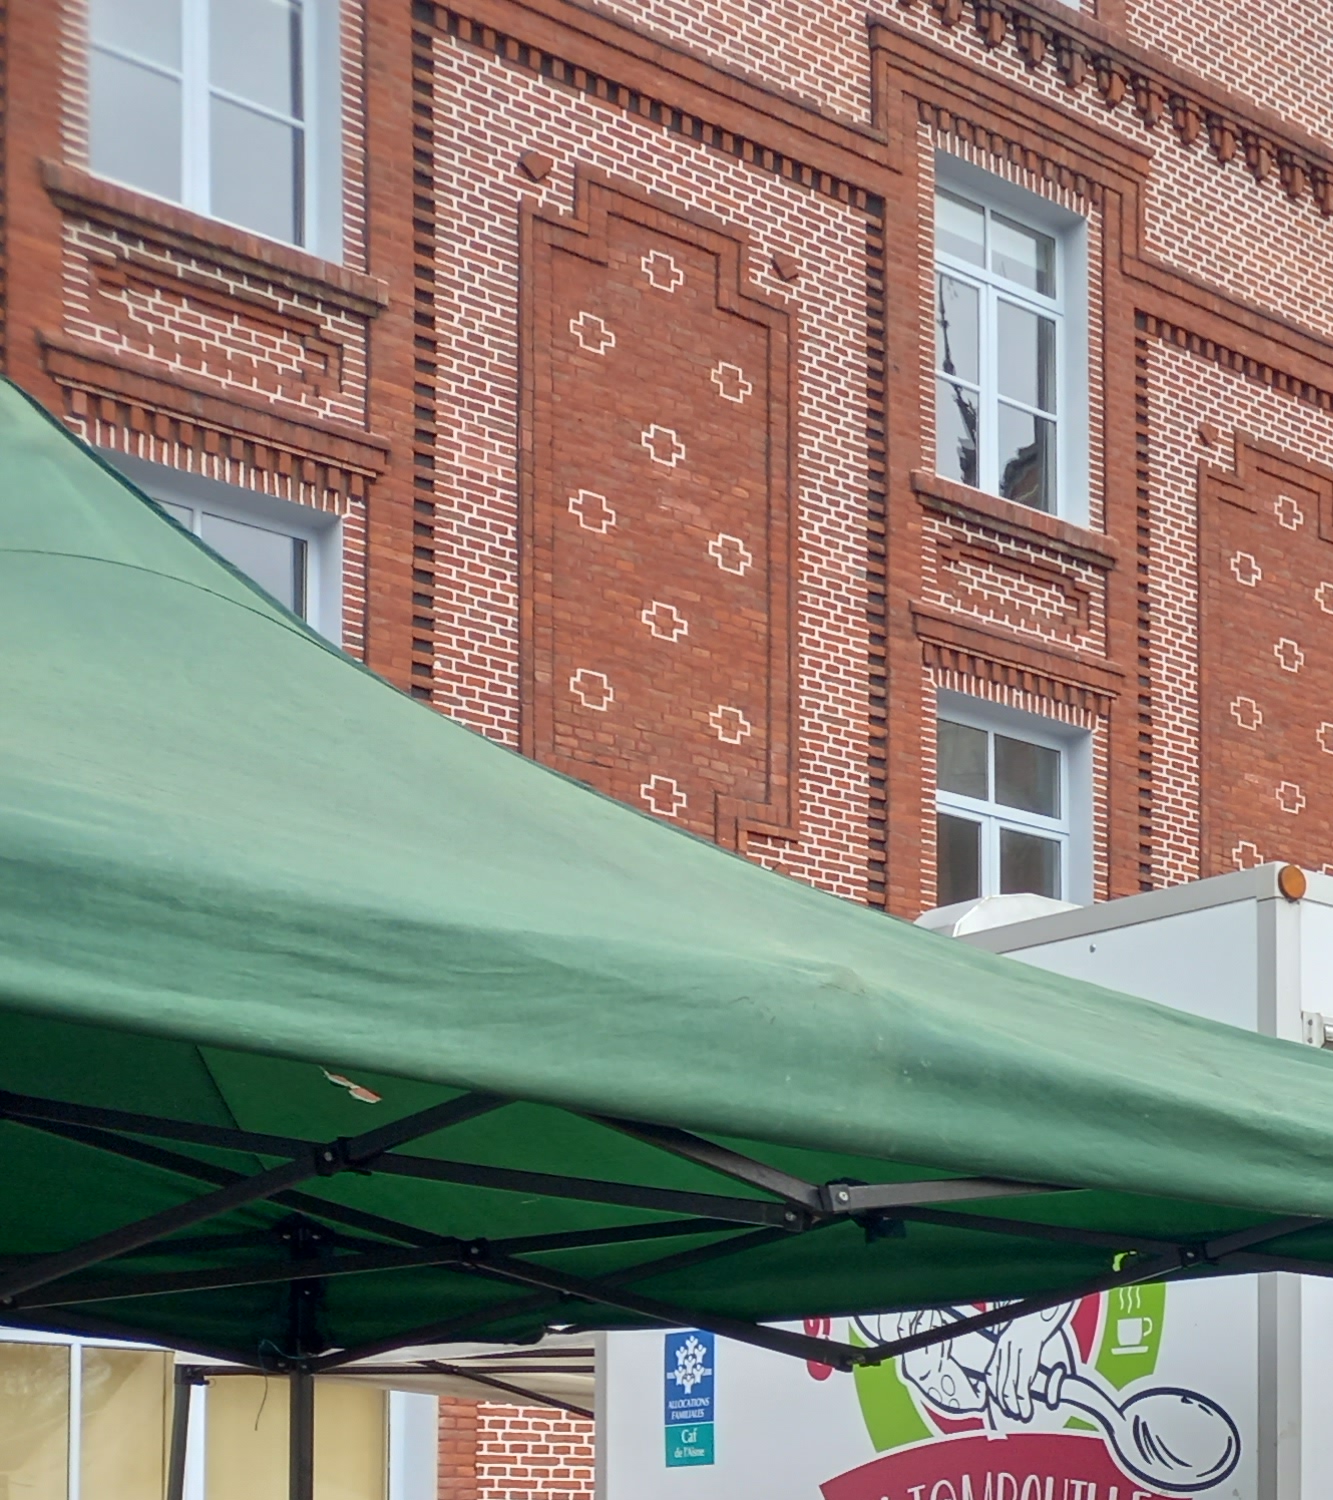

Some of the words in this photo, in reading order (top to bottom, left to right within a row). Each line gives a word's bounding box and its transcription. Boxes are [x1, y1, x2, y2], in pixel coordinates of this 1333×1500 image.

[668, 1397, 710, 1410] ALLOCATIONS
[671, 1410, 704, 1420] FAMILIALES
[681, 1429, 697, 1444] Caf
[674, 1447, 682, 1458] de
[684, 1446, 705, 1458] l'Aisne
